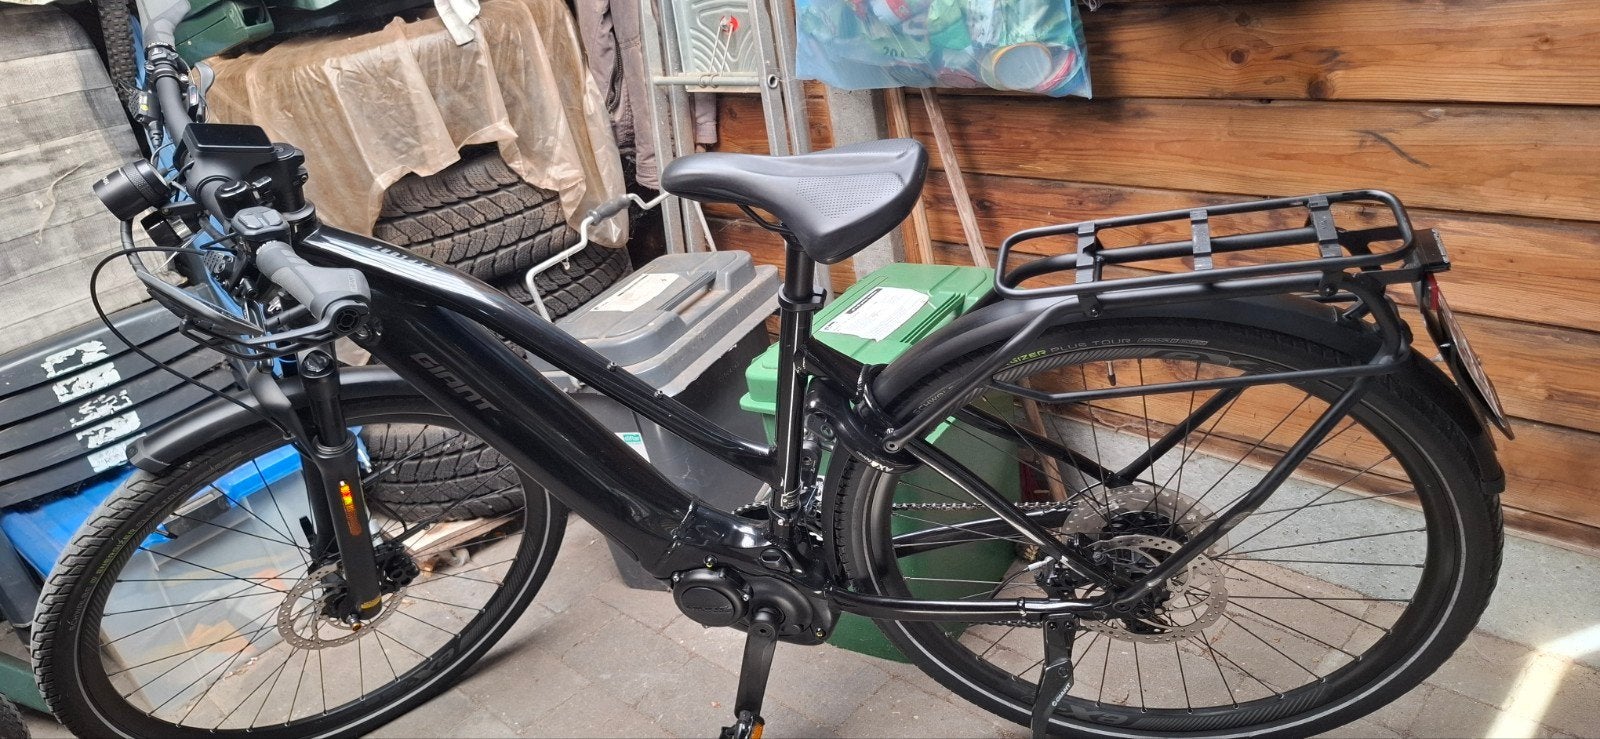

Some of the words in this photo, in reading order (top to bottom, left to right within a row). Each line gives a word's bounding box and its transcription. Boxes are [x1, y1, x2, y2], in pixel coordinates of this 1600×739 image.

[1050, 342, 1087, 353] PLUS
[1091, 338, 1131, 346] TOUR
[410, 352, 502, 412] GIANT
